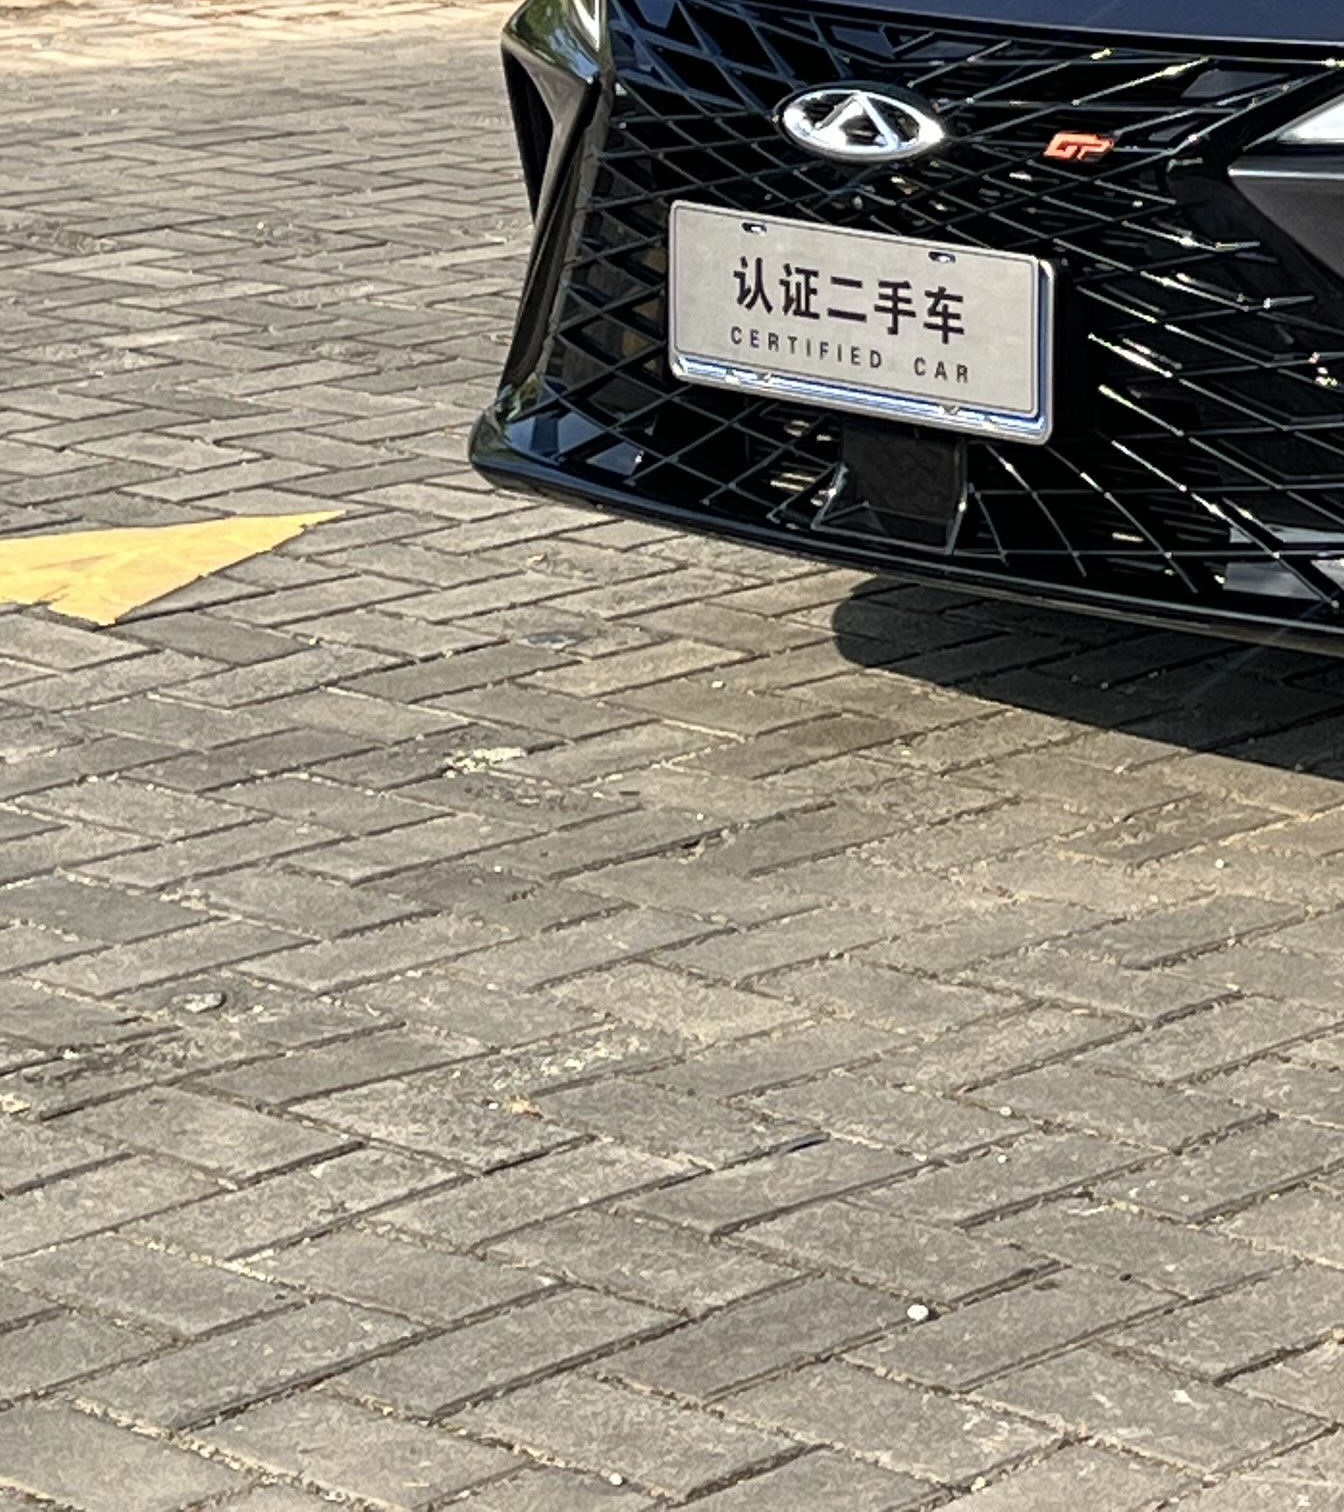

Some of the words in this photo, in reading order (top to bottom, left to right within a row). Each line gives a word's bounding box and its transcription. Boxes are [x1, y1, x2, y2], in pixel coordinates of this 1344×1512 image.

[1043, 132, 1113, 160] GT
[733, 256, 965, 345] 认证二手车
[730, 326, 883, 369] CERTIFIED
[914, 356, 969, 384] CAR
